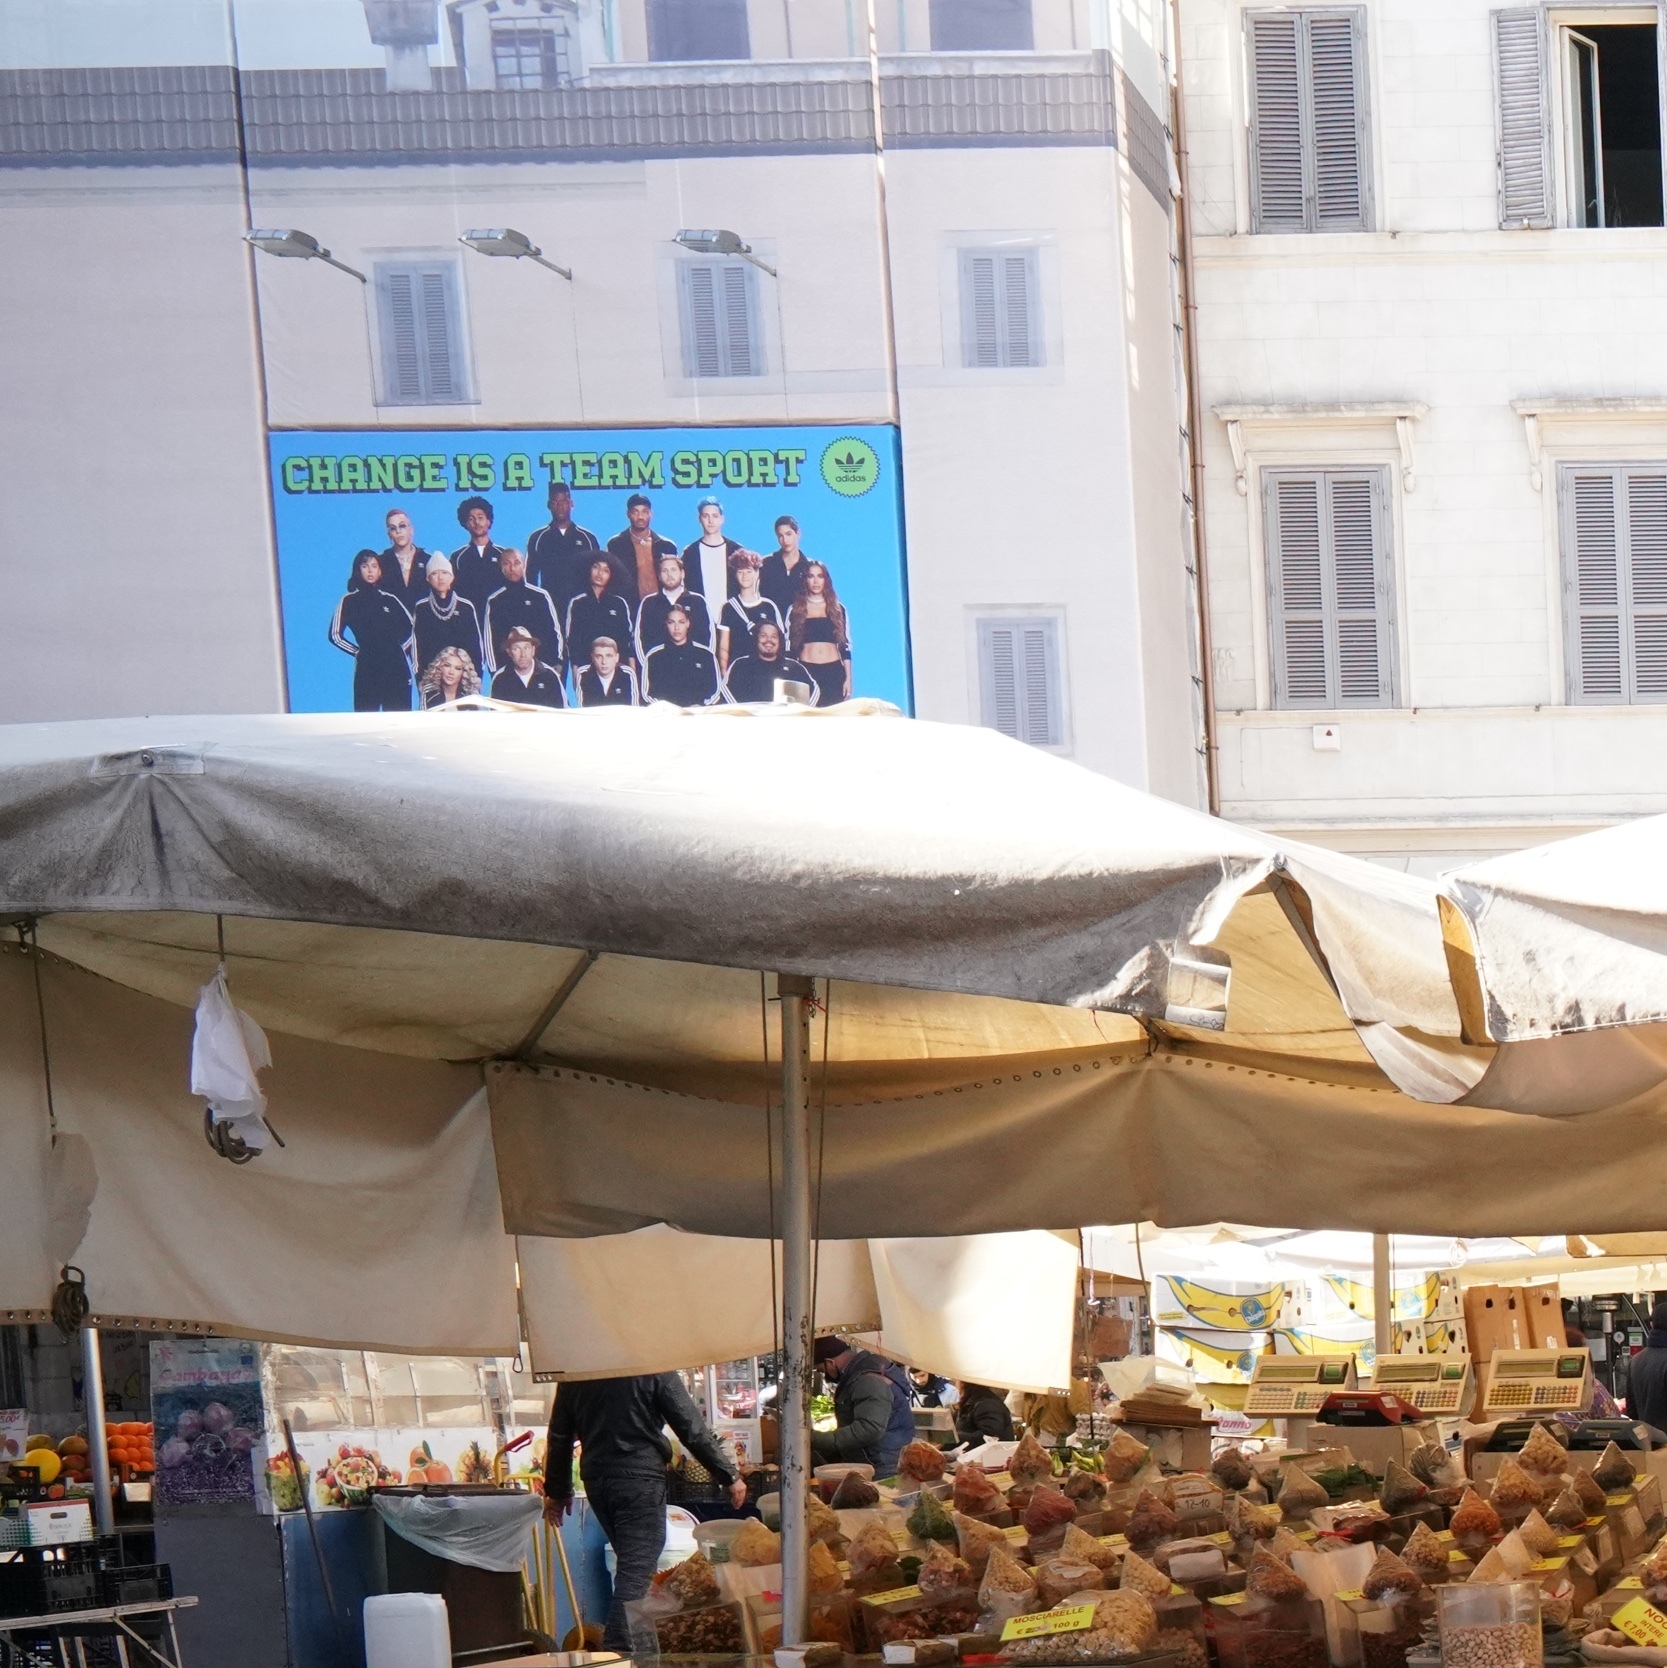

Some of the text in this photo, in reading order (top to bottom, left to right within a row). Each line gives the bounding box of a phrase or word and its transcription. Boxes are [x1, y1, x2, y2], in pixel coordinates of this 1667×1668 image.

[282, 449, 807, 494] CHANGE IS A TEAM SPORT
[836, 474, 866, 483] adidas
[1013, 1607, 1085, 1625] MOSCIARELLE
[1053, 1621, 1068, 1629] 100
[1640, 1619, 1664, 1639] INTERE
